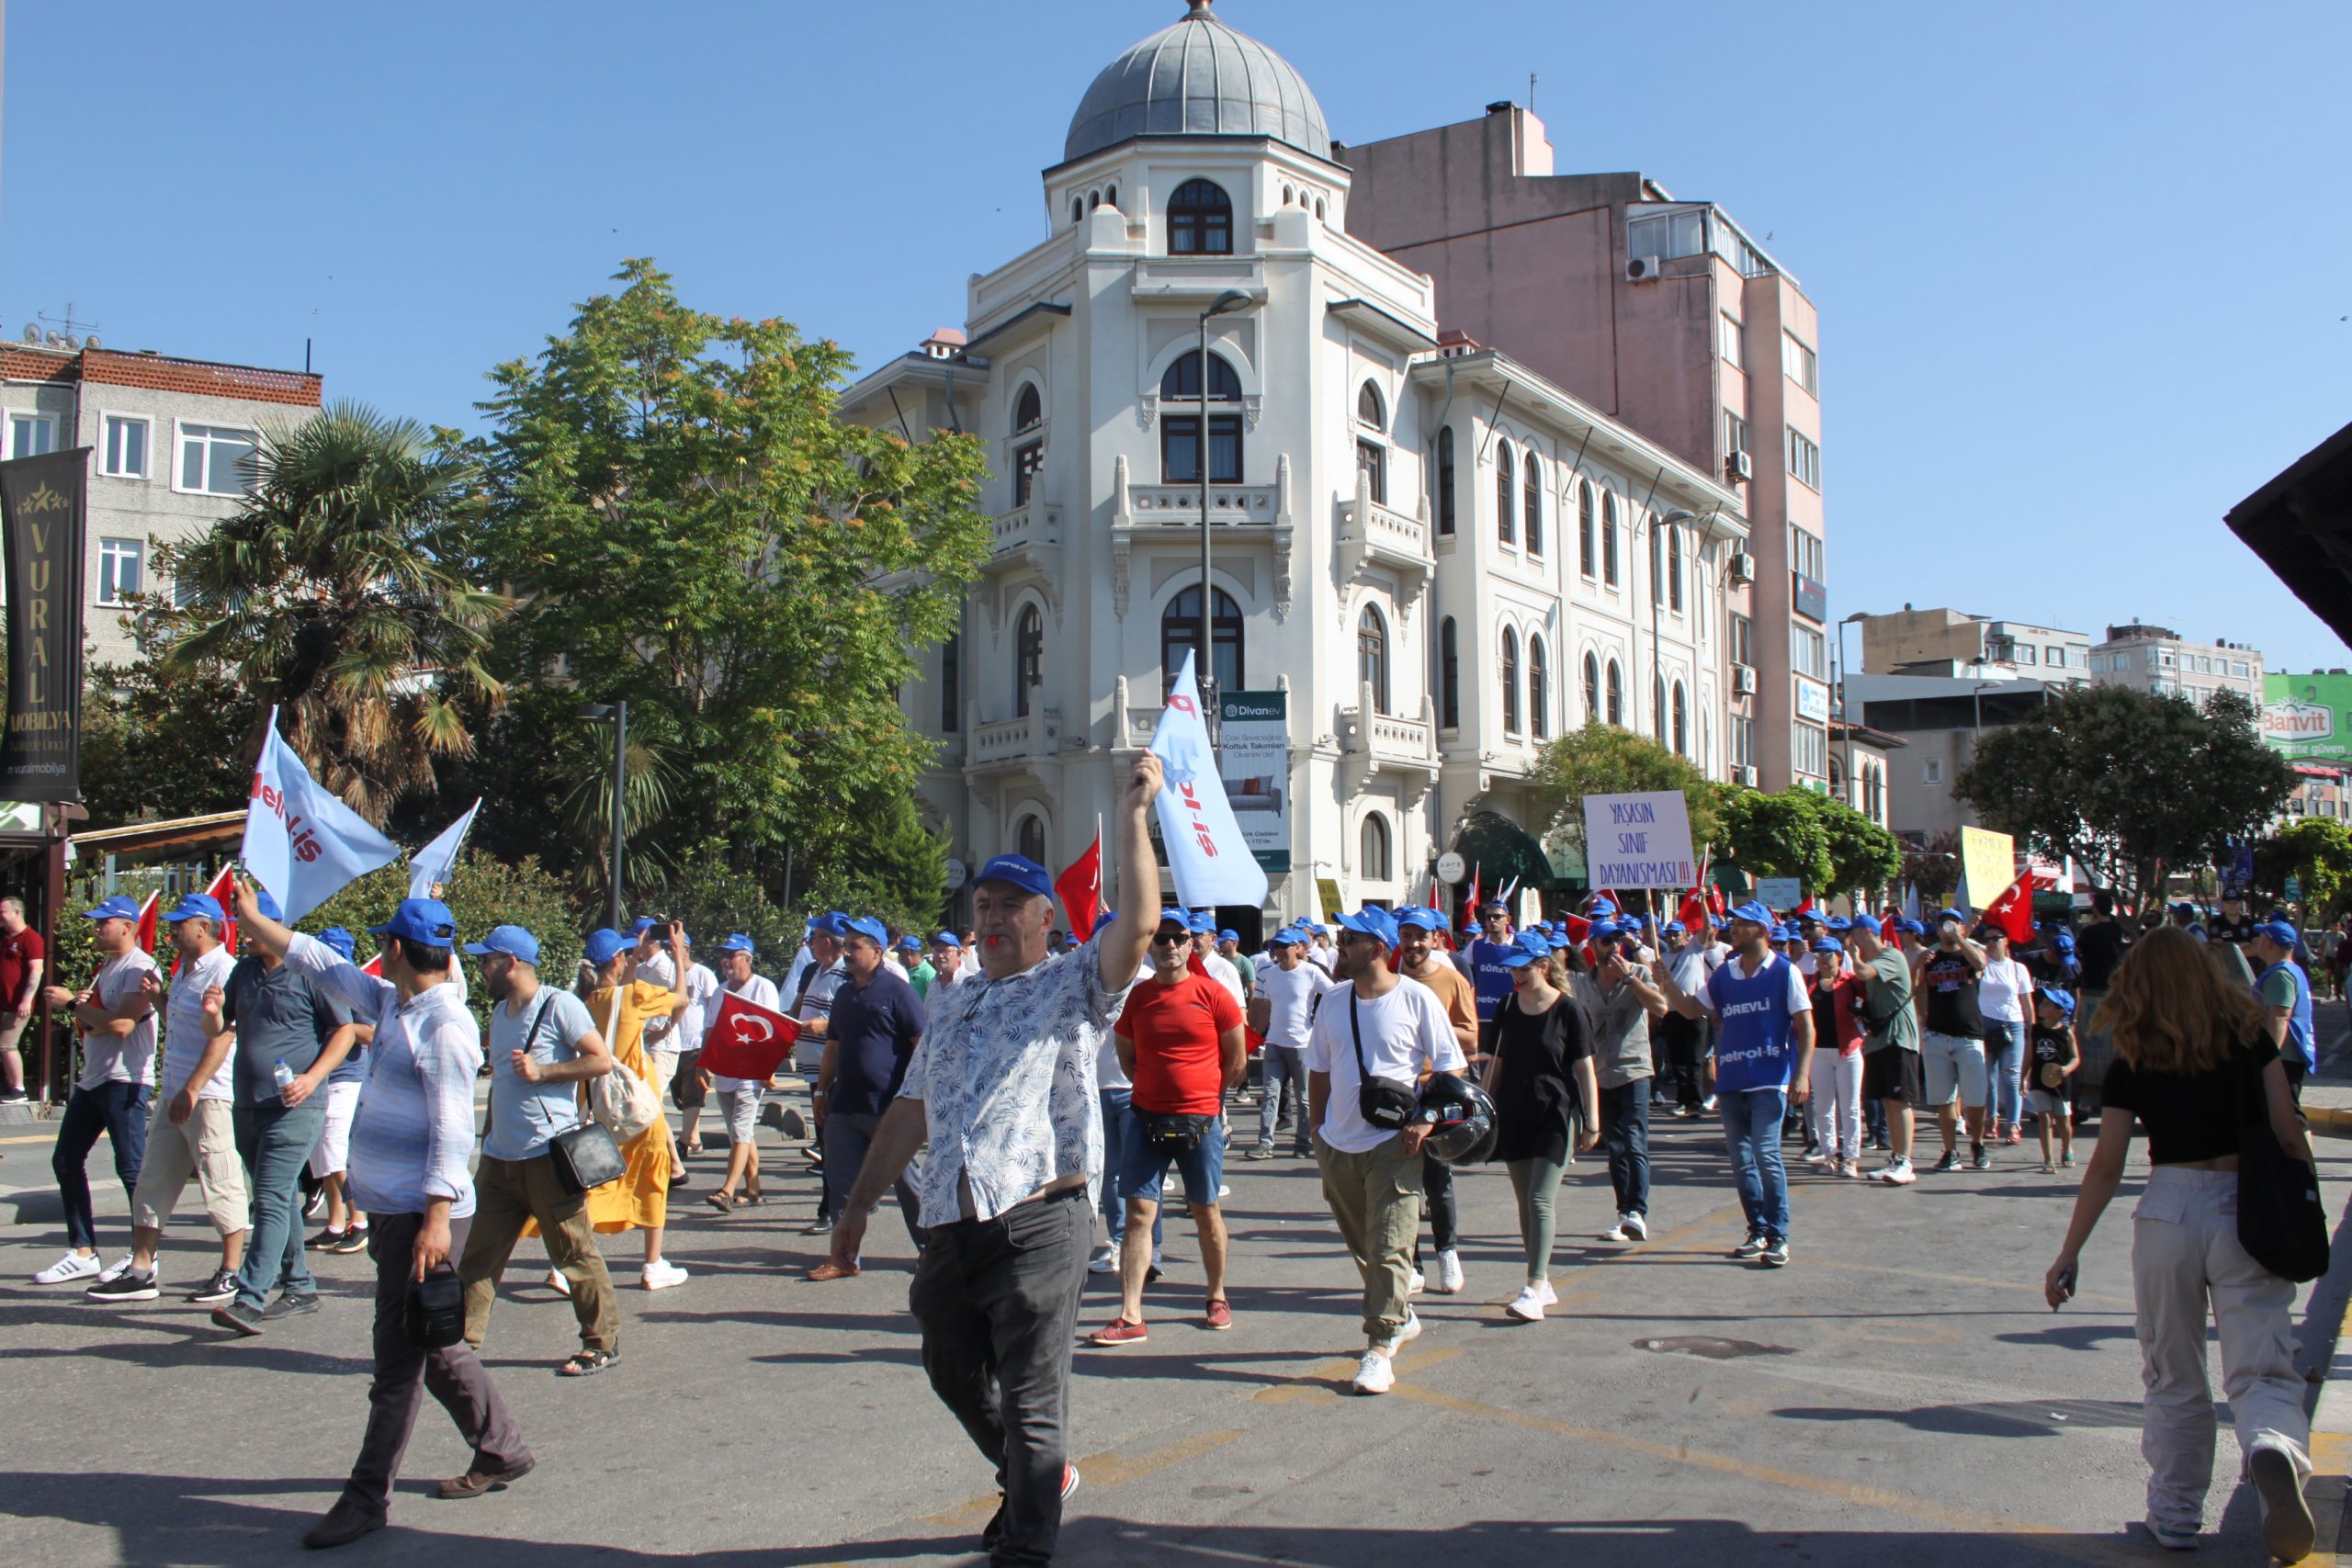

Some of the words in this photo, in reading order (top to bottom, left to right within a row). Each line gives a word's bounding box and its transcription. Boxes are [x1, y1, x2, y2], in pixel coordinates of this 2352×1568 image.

[29, 521, 51, 704] VURAL
[1238, 705, 1281, 716] Divanev
[2264, 712, 2326, 731] Banvit
[2312, 743, 2346, 756] güven
[1610, 802, 1655, 826] YAŞASIN
[1618, 832, 1649, 854] SINIF
[1480, 964, 1510, 974] GÖREV
[1476, 996, 1500, 1004] petr
[1374, 1107, 1401, 1121] PUMA
